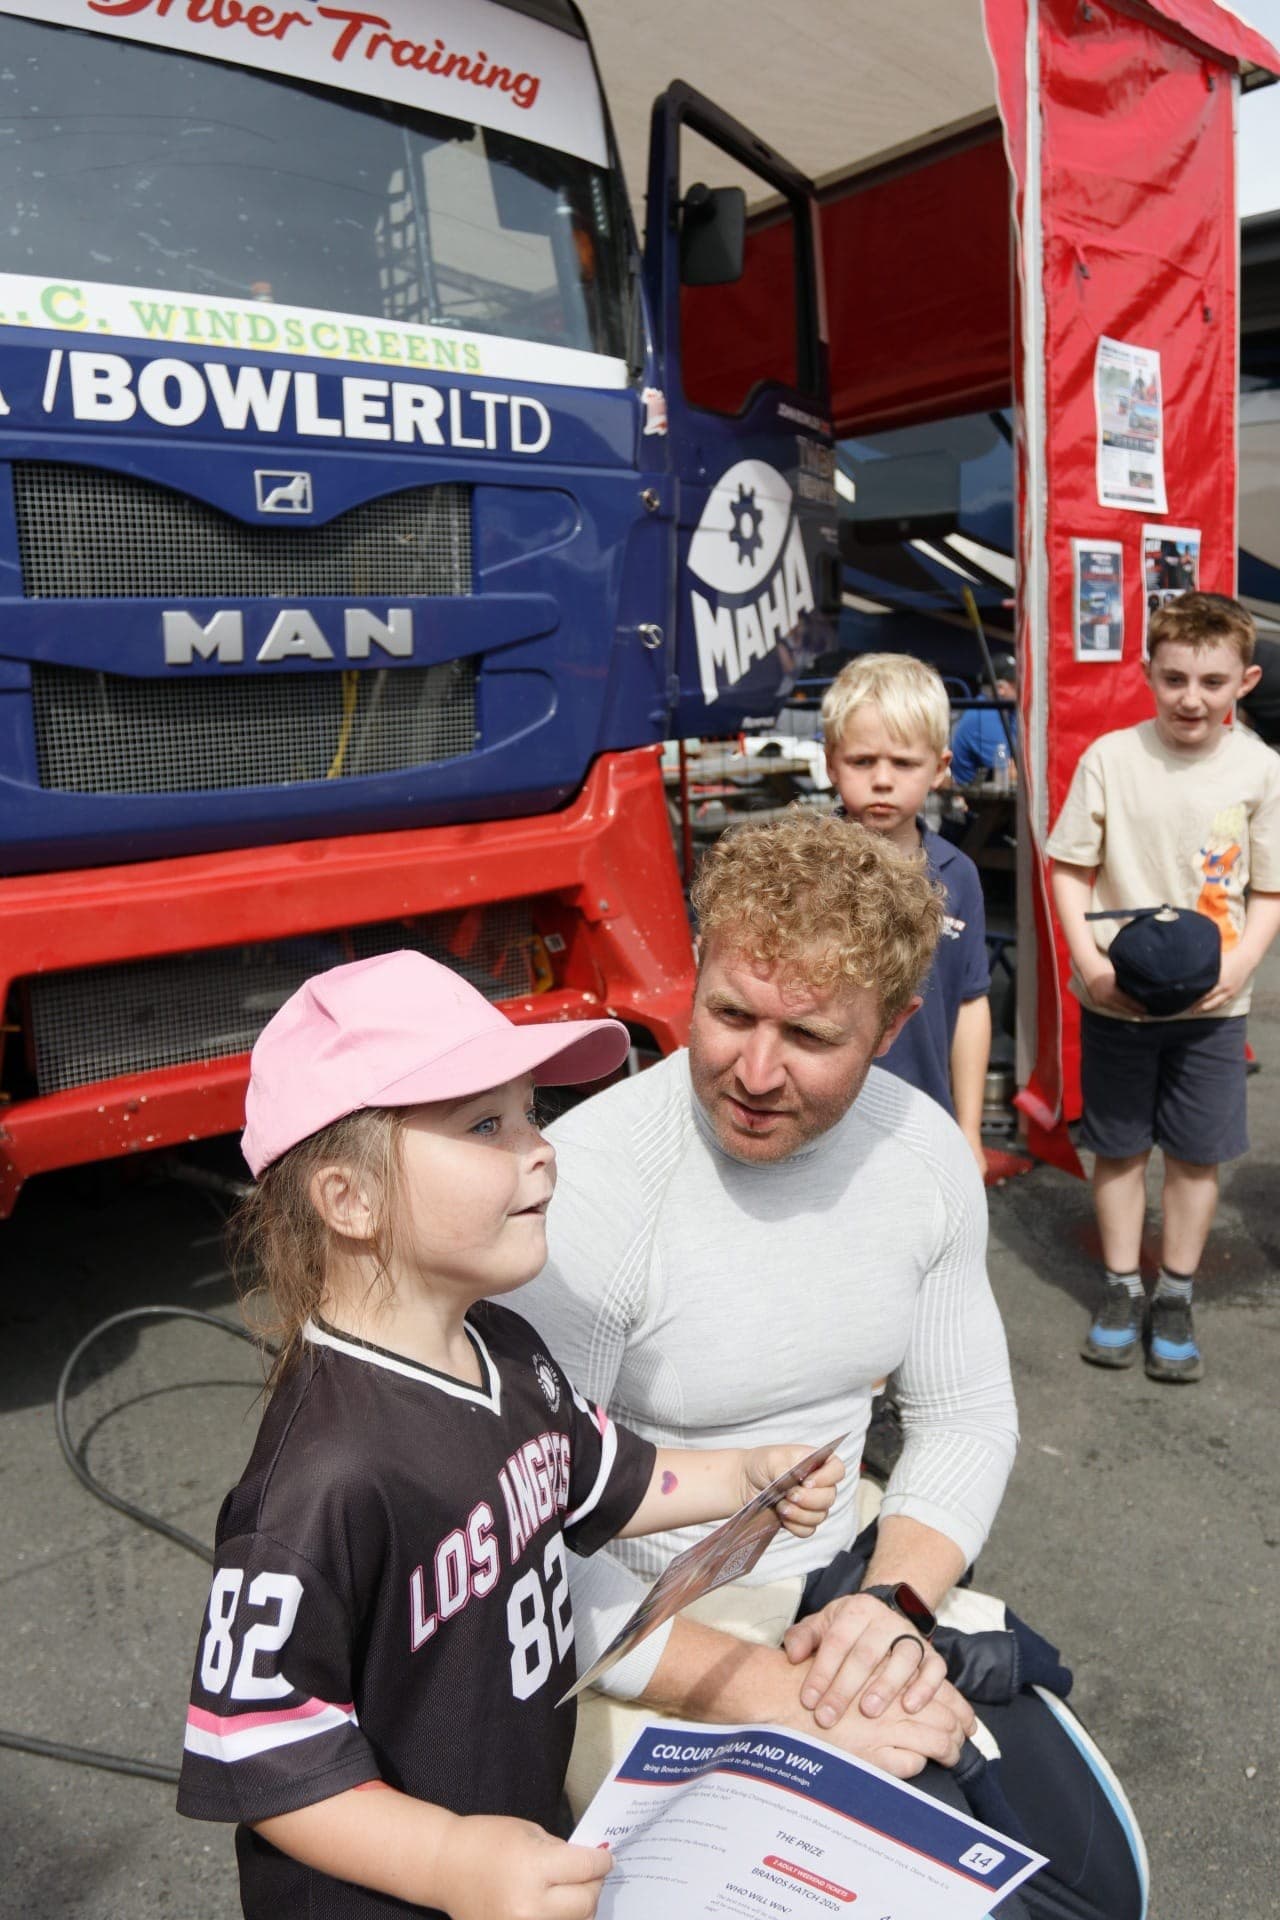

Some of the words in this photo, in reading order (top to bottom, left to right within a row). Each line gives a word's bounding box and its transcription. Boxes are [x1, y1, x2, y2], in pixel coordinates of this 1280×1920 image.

[317, 6, 541, 109] Training
[129, 300, 484, 375] WINDSCREENS
[163, 608, 414, 665] MAN
[690, 513, 815, 705] MAHA
[409, 1501, 500, 1652] LOS
[200, 1568, 304, 1700] 82
[506, 1529, 575, 1700] 82
[651, 1743, 713, 1761] COLOUR
[750, 1743, 785, 1761] AND
[785, 1752, 824, 1777] WIN!
[776, 1830, 797, 1845] THE
[795, 1839, 825, 1858] PRIZE
[969, 1852, 993, 1868] 14
[725, 1882, 748, 1897] WHO
[748, 1891, 769, 1905] WILL
[769, 1900, 793, 1914] WIN?
[751, 1867, 788, 1888] BRANDS
[788, 1882, 820, 1902] HATCH
[819, 1898, 841, 1913] 2026
